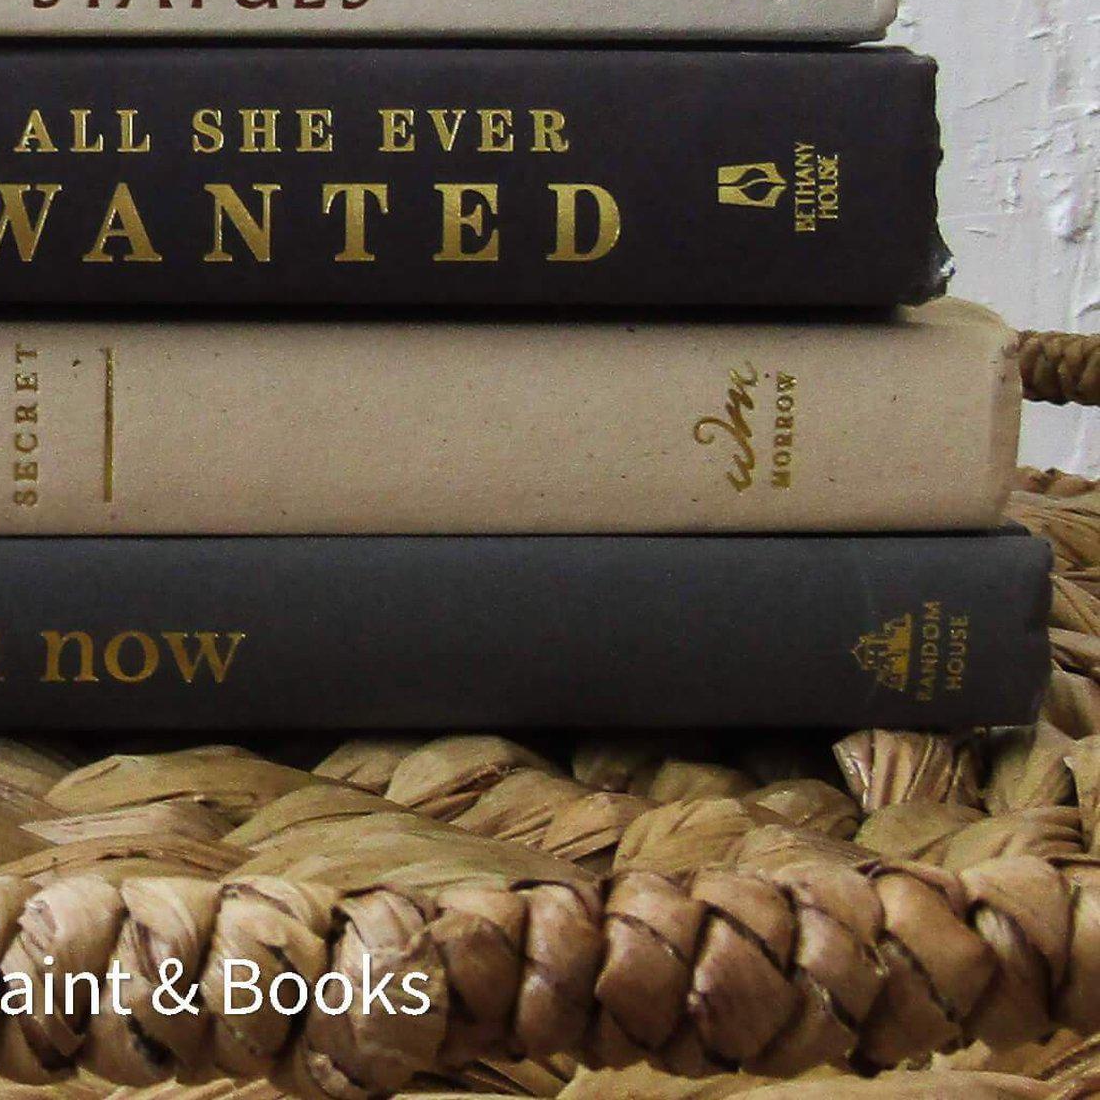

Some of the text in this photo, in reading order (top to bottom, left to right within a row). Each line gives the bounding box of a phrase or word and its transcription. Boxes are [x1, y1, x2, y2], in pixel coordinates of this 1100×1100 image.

[13, 109, 570, 153] ALL SHE EVER
[795, 142, 815, 232] BETHANY
[13, 343, 38, 507] SECRET
[772, 371, 797, 489] MORROW
[40, 629, 246, 683] now
[917, 600, 941, 700] RANDOM
[947, 615, 968, 689] HOUSE
